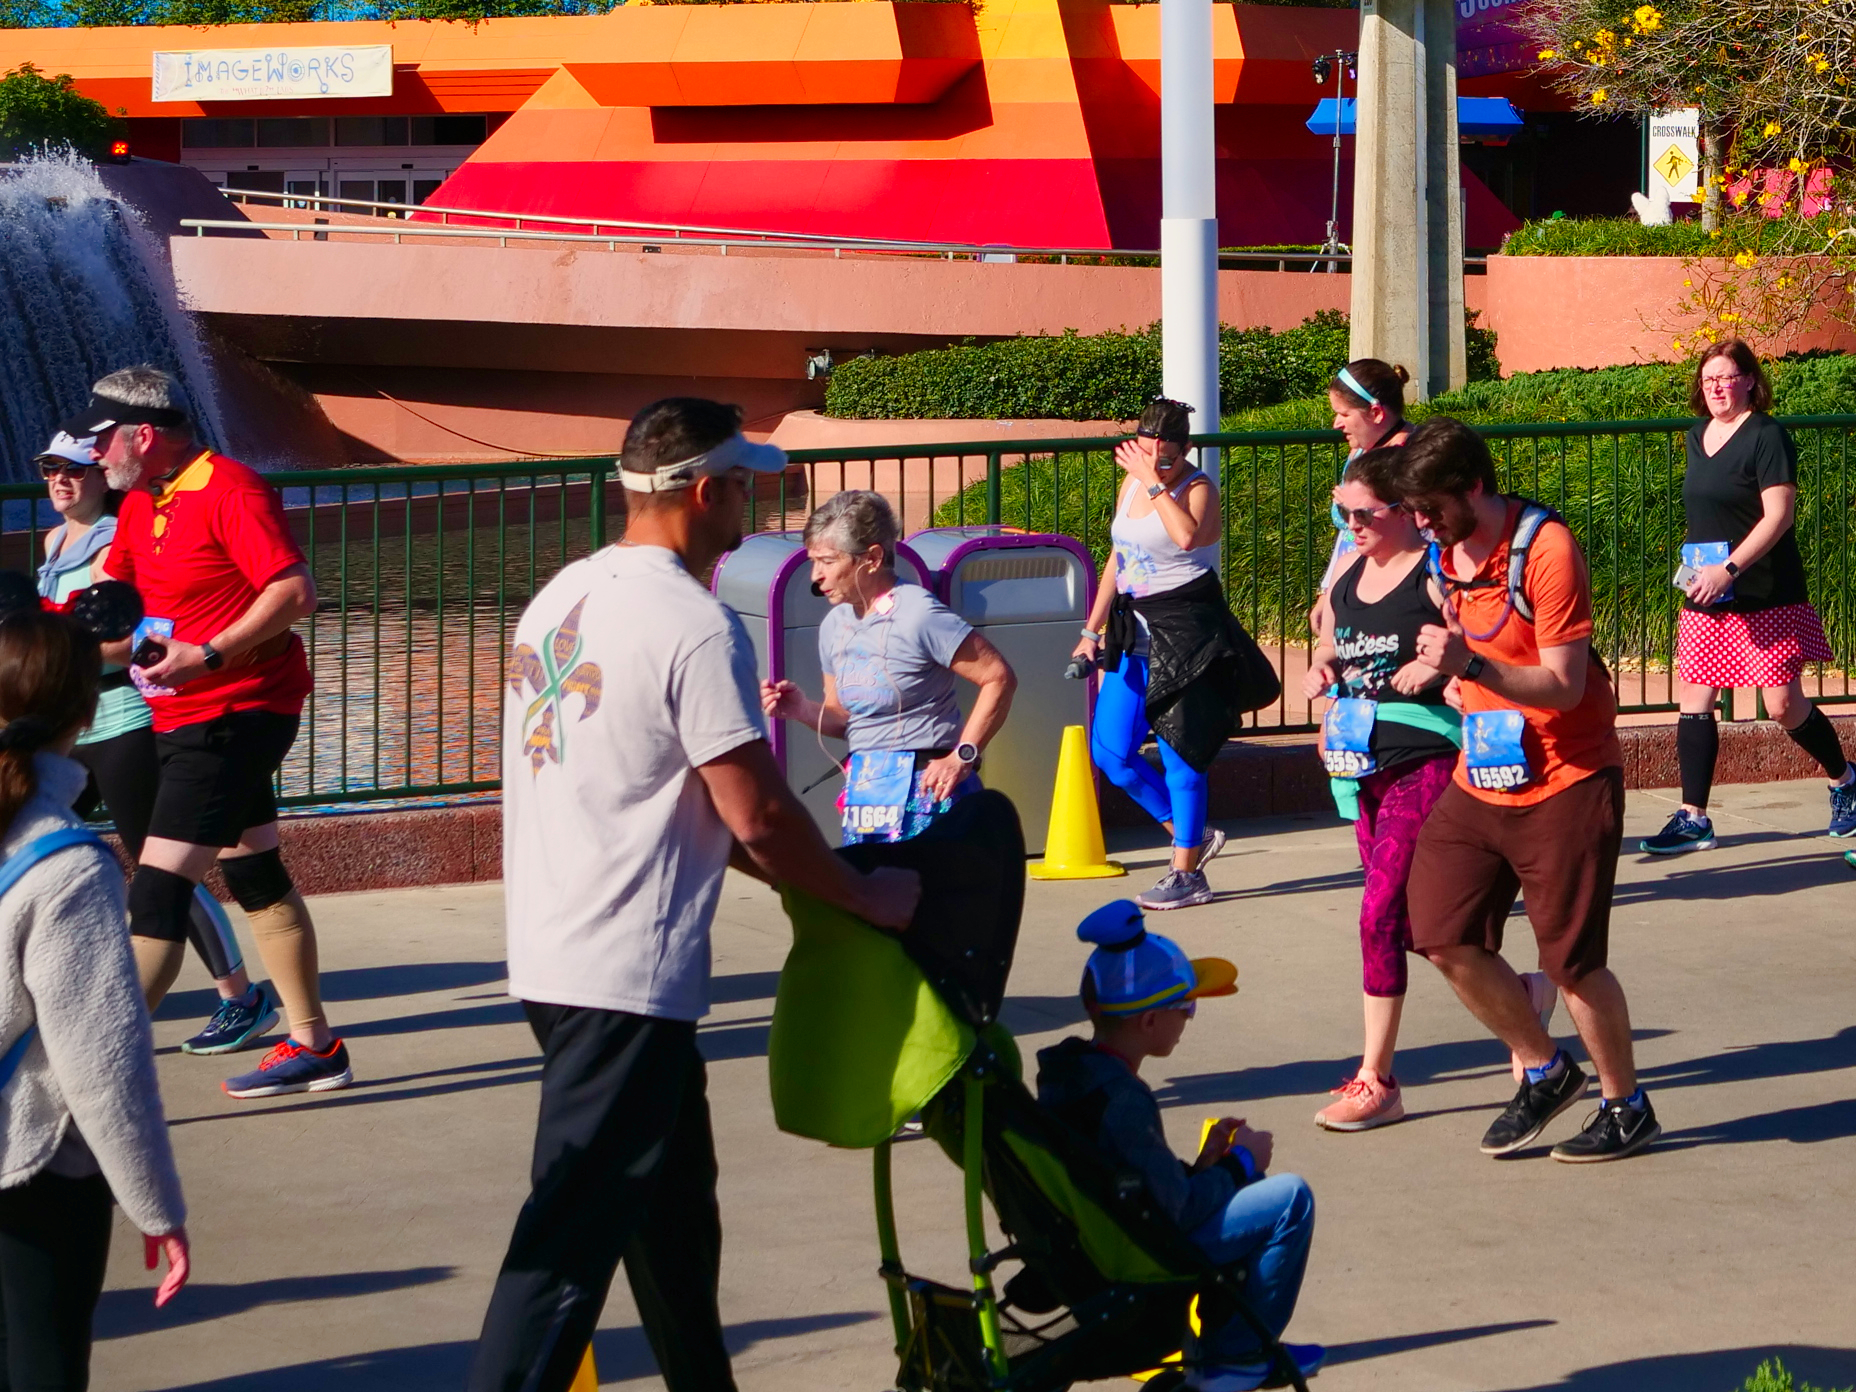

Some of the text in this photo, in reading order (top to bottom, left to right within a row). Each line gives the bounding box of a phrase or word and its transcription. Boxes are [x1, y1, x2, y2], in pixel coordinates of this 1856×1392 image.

[1652, 125, 1696, 137] CROSSWALK
[1507, 714, 1519, 727] H
[1470, 764, 1529, 788] 15592
[842, 805, 899, 828] 11664
